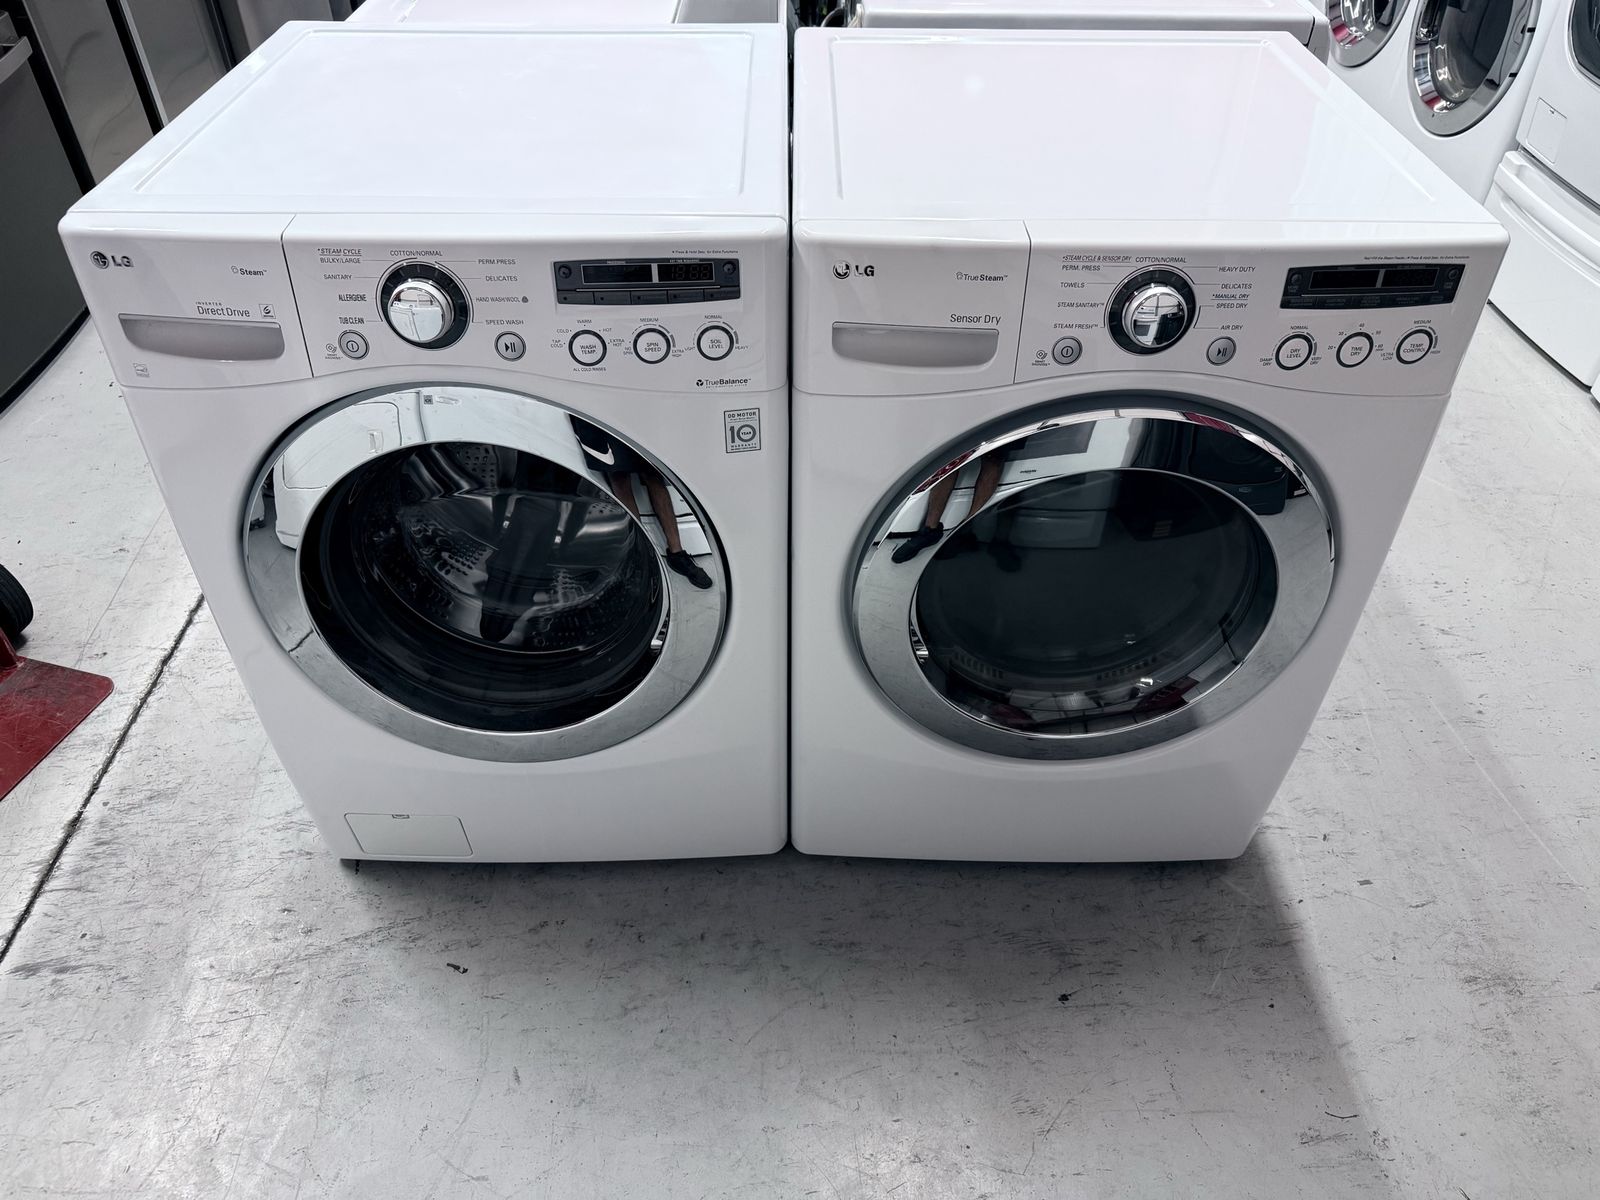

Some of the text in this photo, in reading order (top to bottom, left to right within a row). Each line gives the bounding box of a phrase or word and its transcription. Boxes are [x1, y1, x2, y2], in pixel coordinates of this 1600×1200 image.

[111, 255, 134, 268] LG
[854, 265, 874, 276] LG
[950, 314, 1001, 325] Sensor Dry
[730, 424, 756, 443] 10
